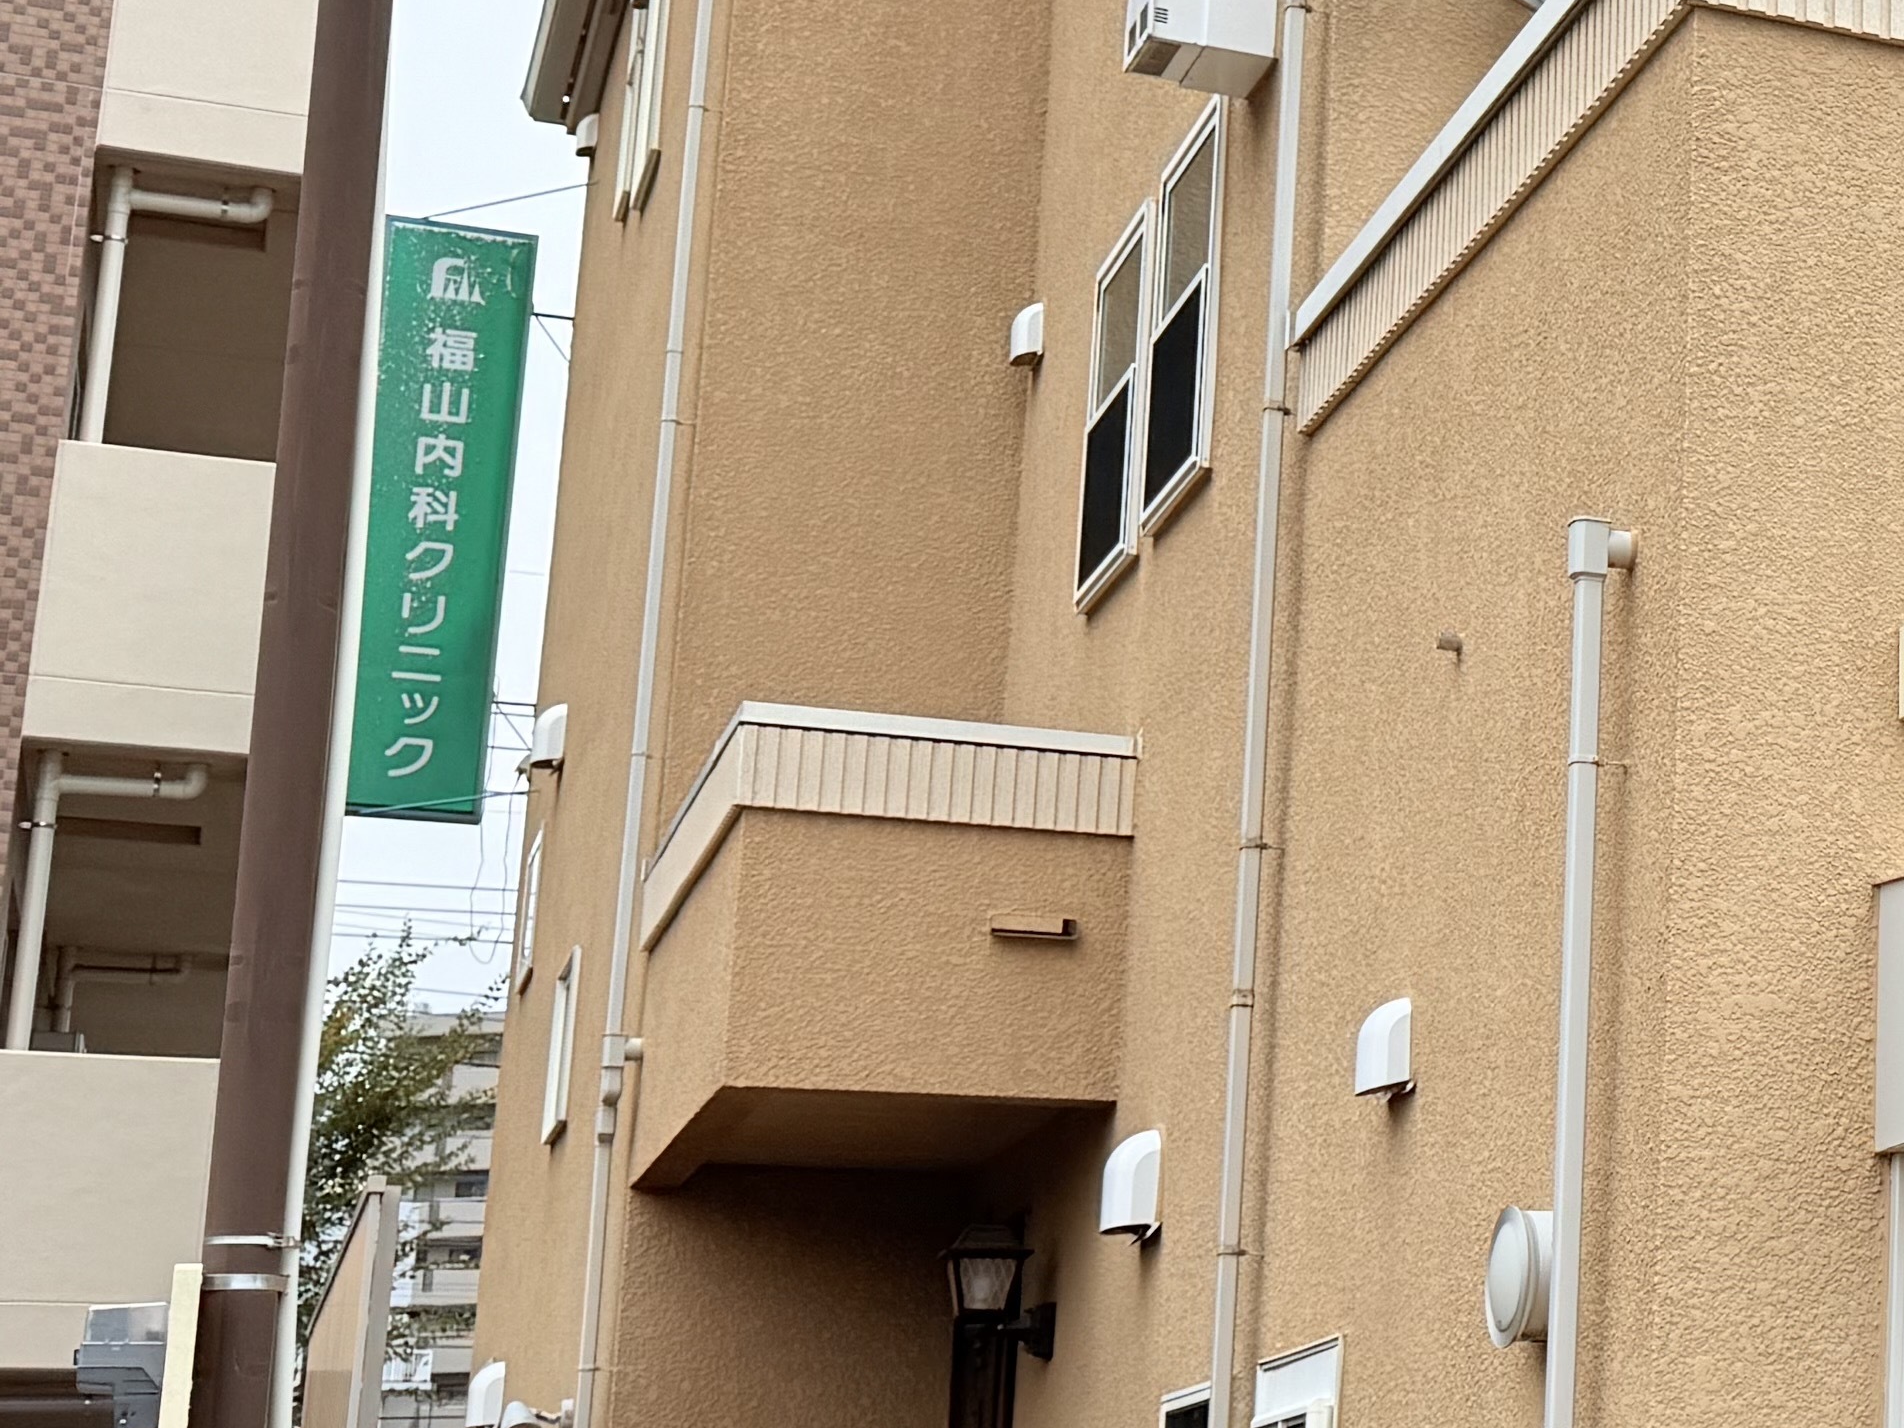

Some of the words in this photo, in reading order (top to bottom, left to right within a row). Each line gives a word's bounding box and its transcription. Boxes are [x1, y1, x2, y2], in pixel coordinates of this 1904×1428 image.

[384, 327, 479, 778] 福山内科クリニック
